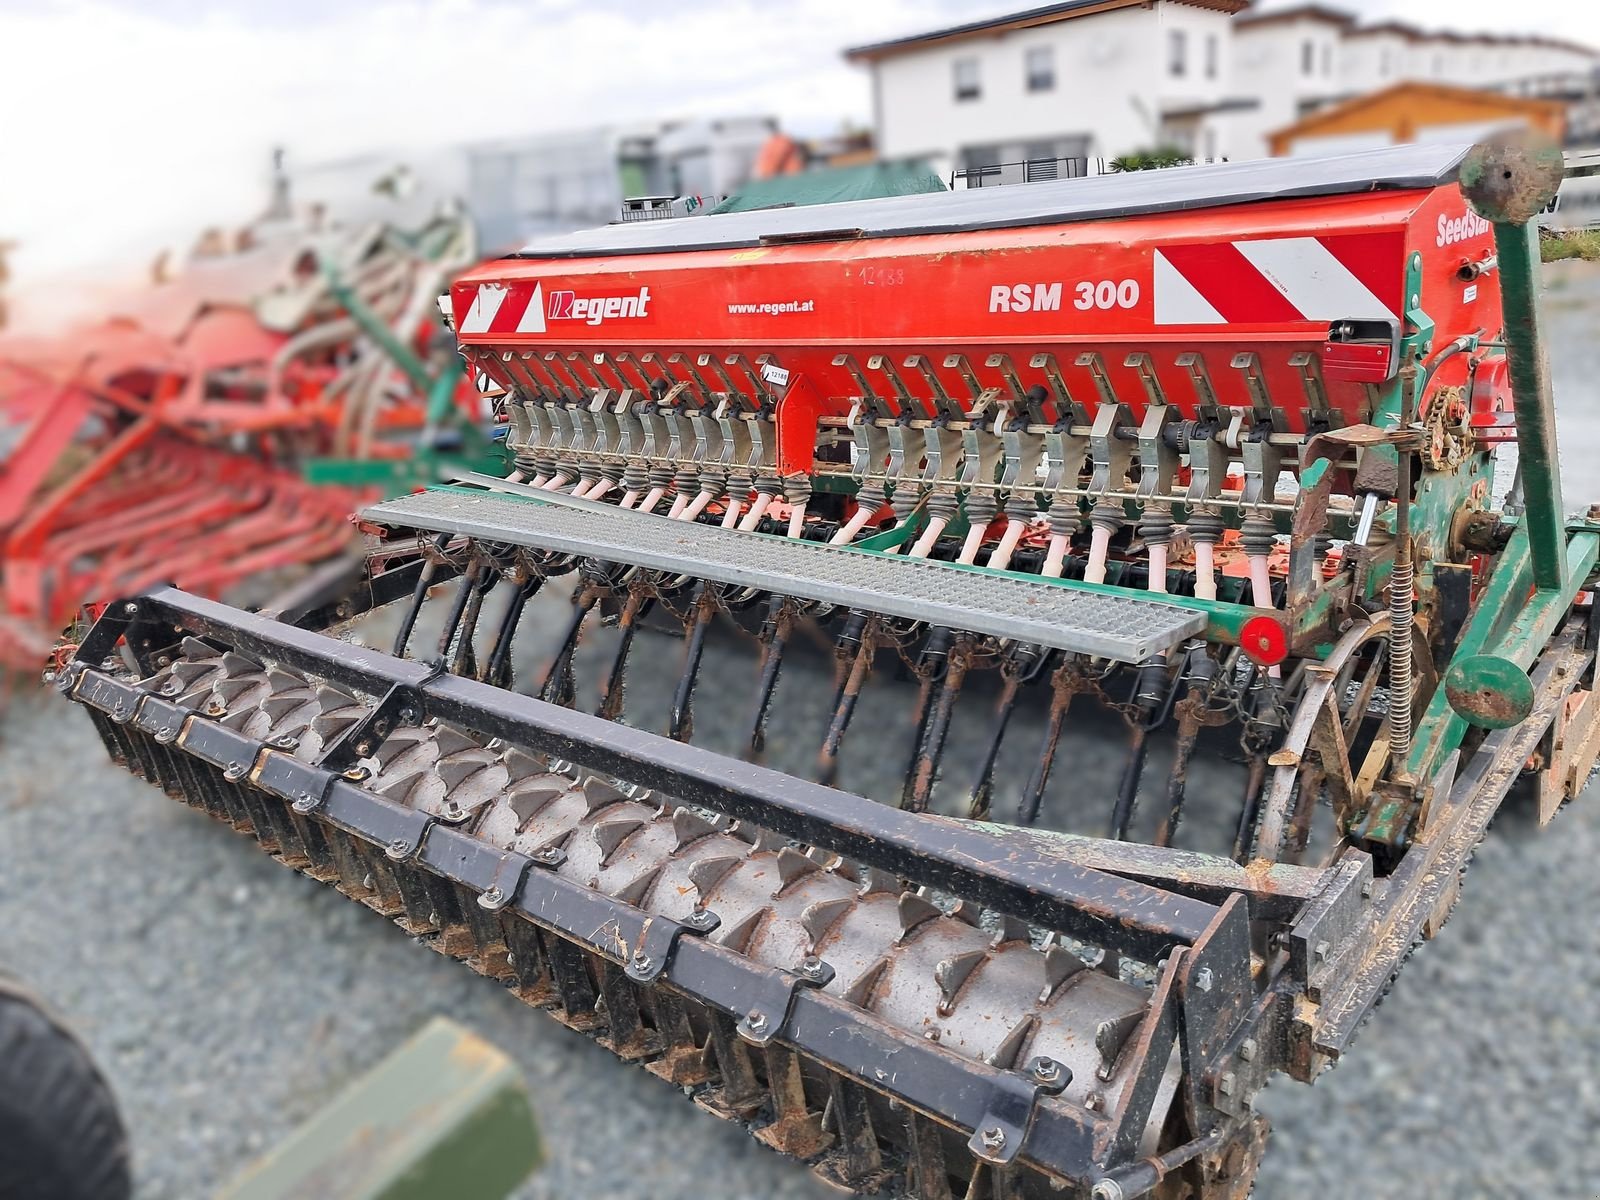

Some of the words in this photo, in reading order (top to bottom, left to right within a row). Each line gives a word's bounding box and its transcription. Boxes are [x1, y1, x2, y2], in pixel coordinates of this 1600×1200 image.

[547, 286, 651, 326] Regent
[727, 299, 815, 316] www.regent.at
[988, 282, 1063, 313] RSM
[1073, 278, 1141, 311] 300
